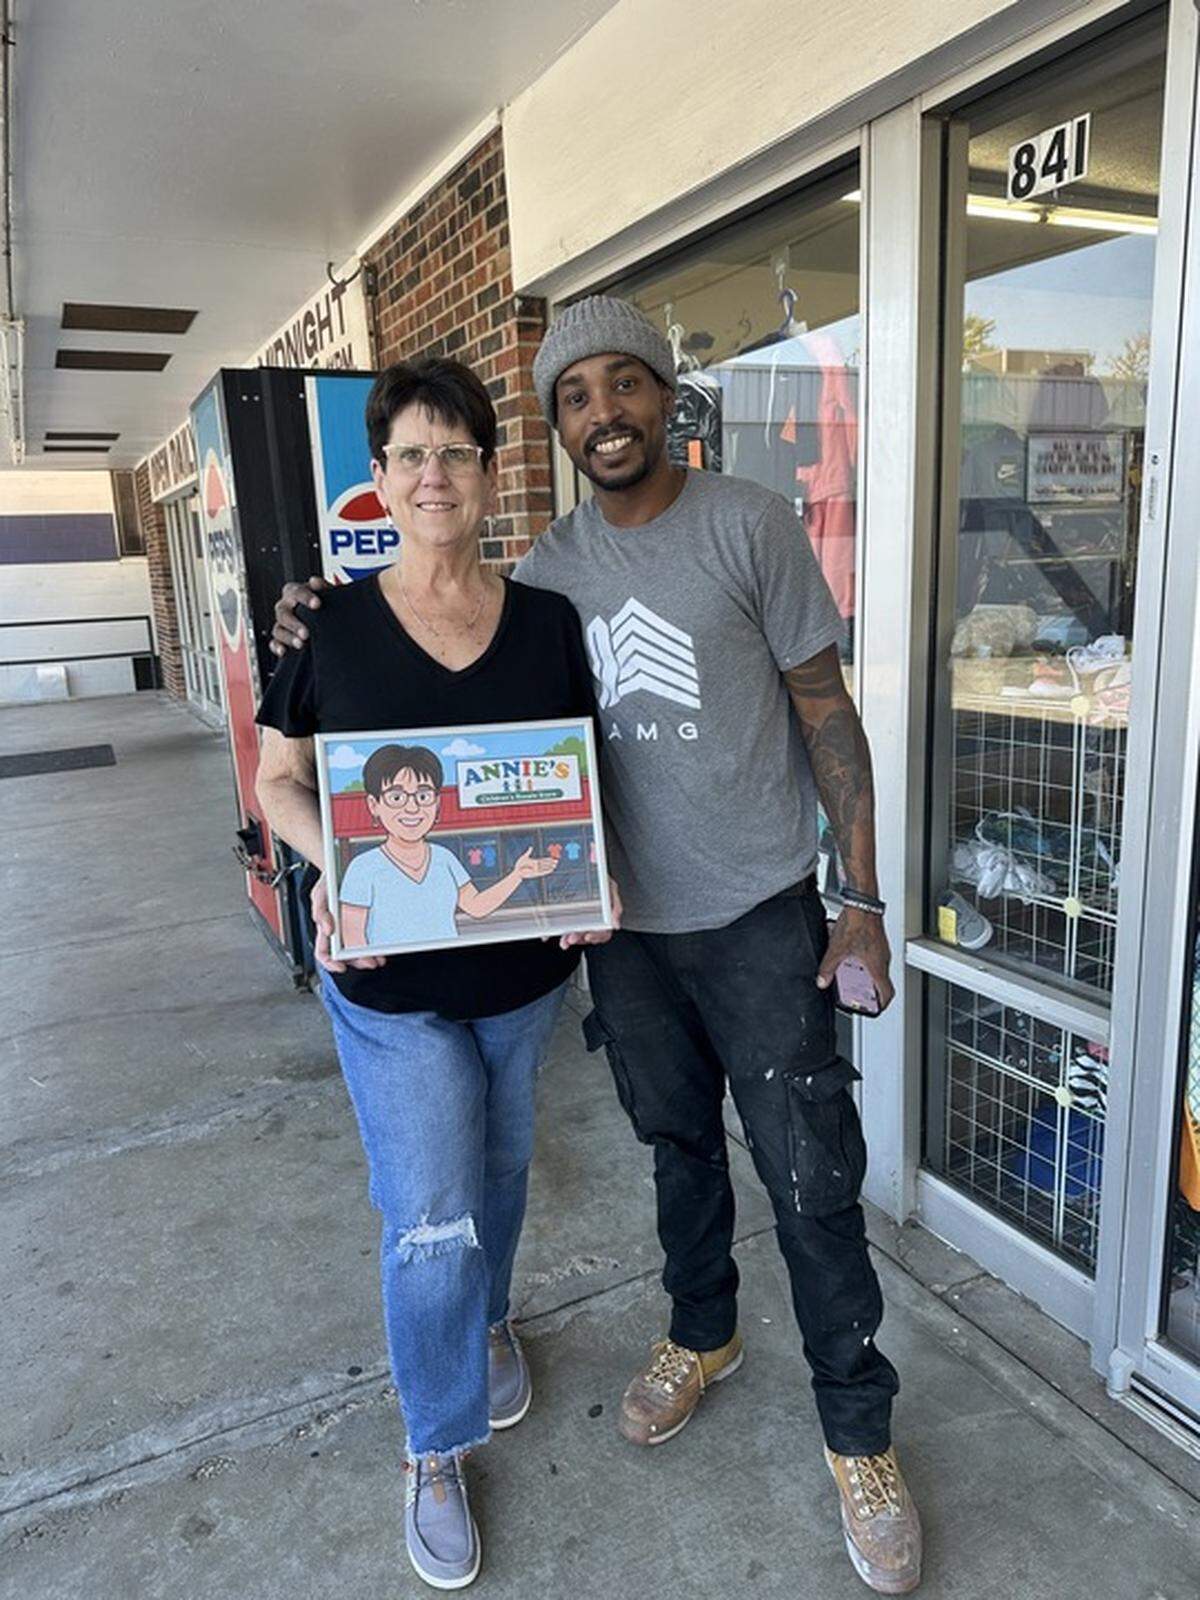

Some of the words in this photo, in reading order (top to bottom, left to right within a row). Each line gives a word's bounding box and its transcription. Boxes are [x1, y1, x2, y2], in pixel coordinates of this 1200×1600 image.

[1011, 118, 1086, 198] 841
[330, 528, 400, 555] PEP
[465, 760, 570, 786] ANNIE'S
